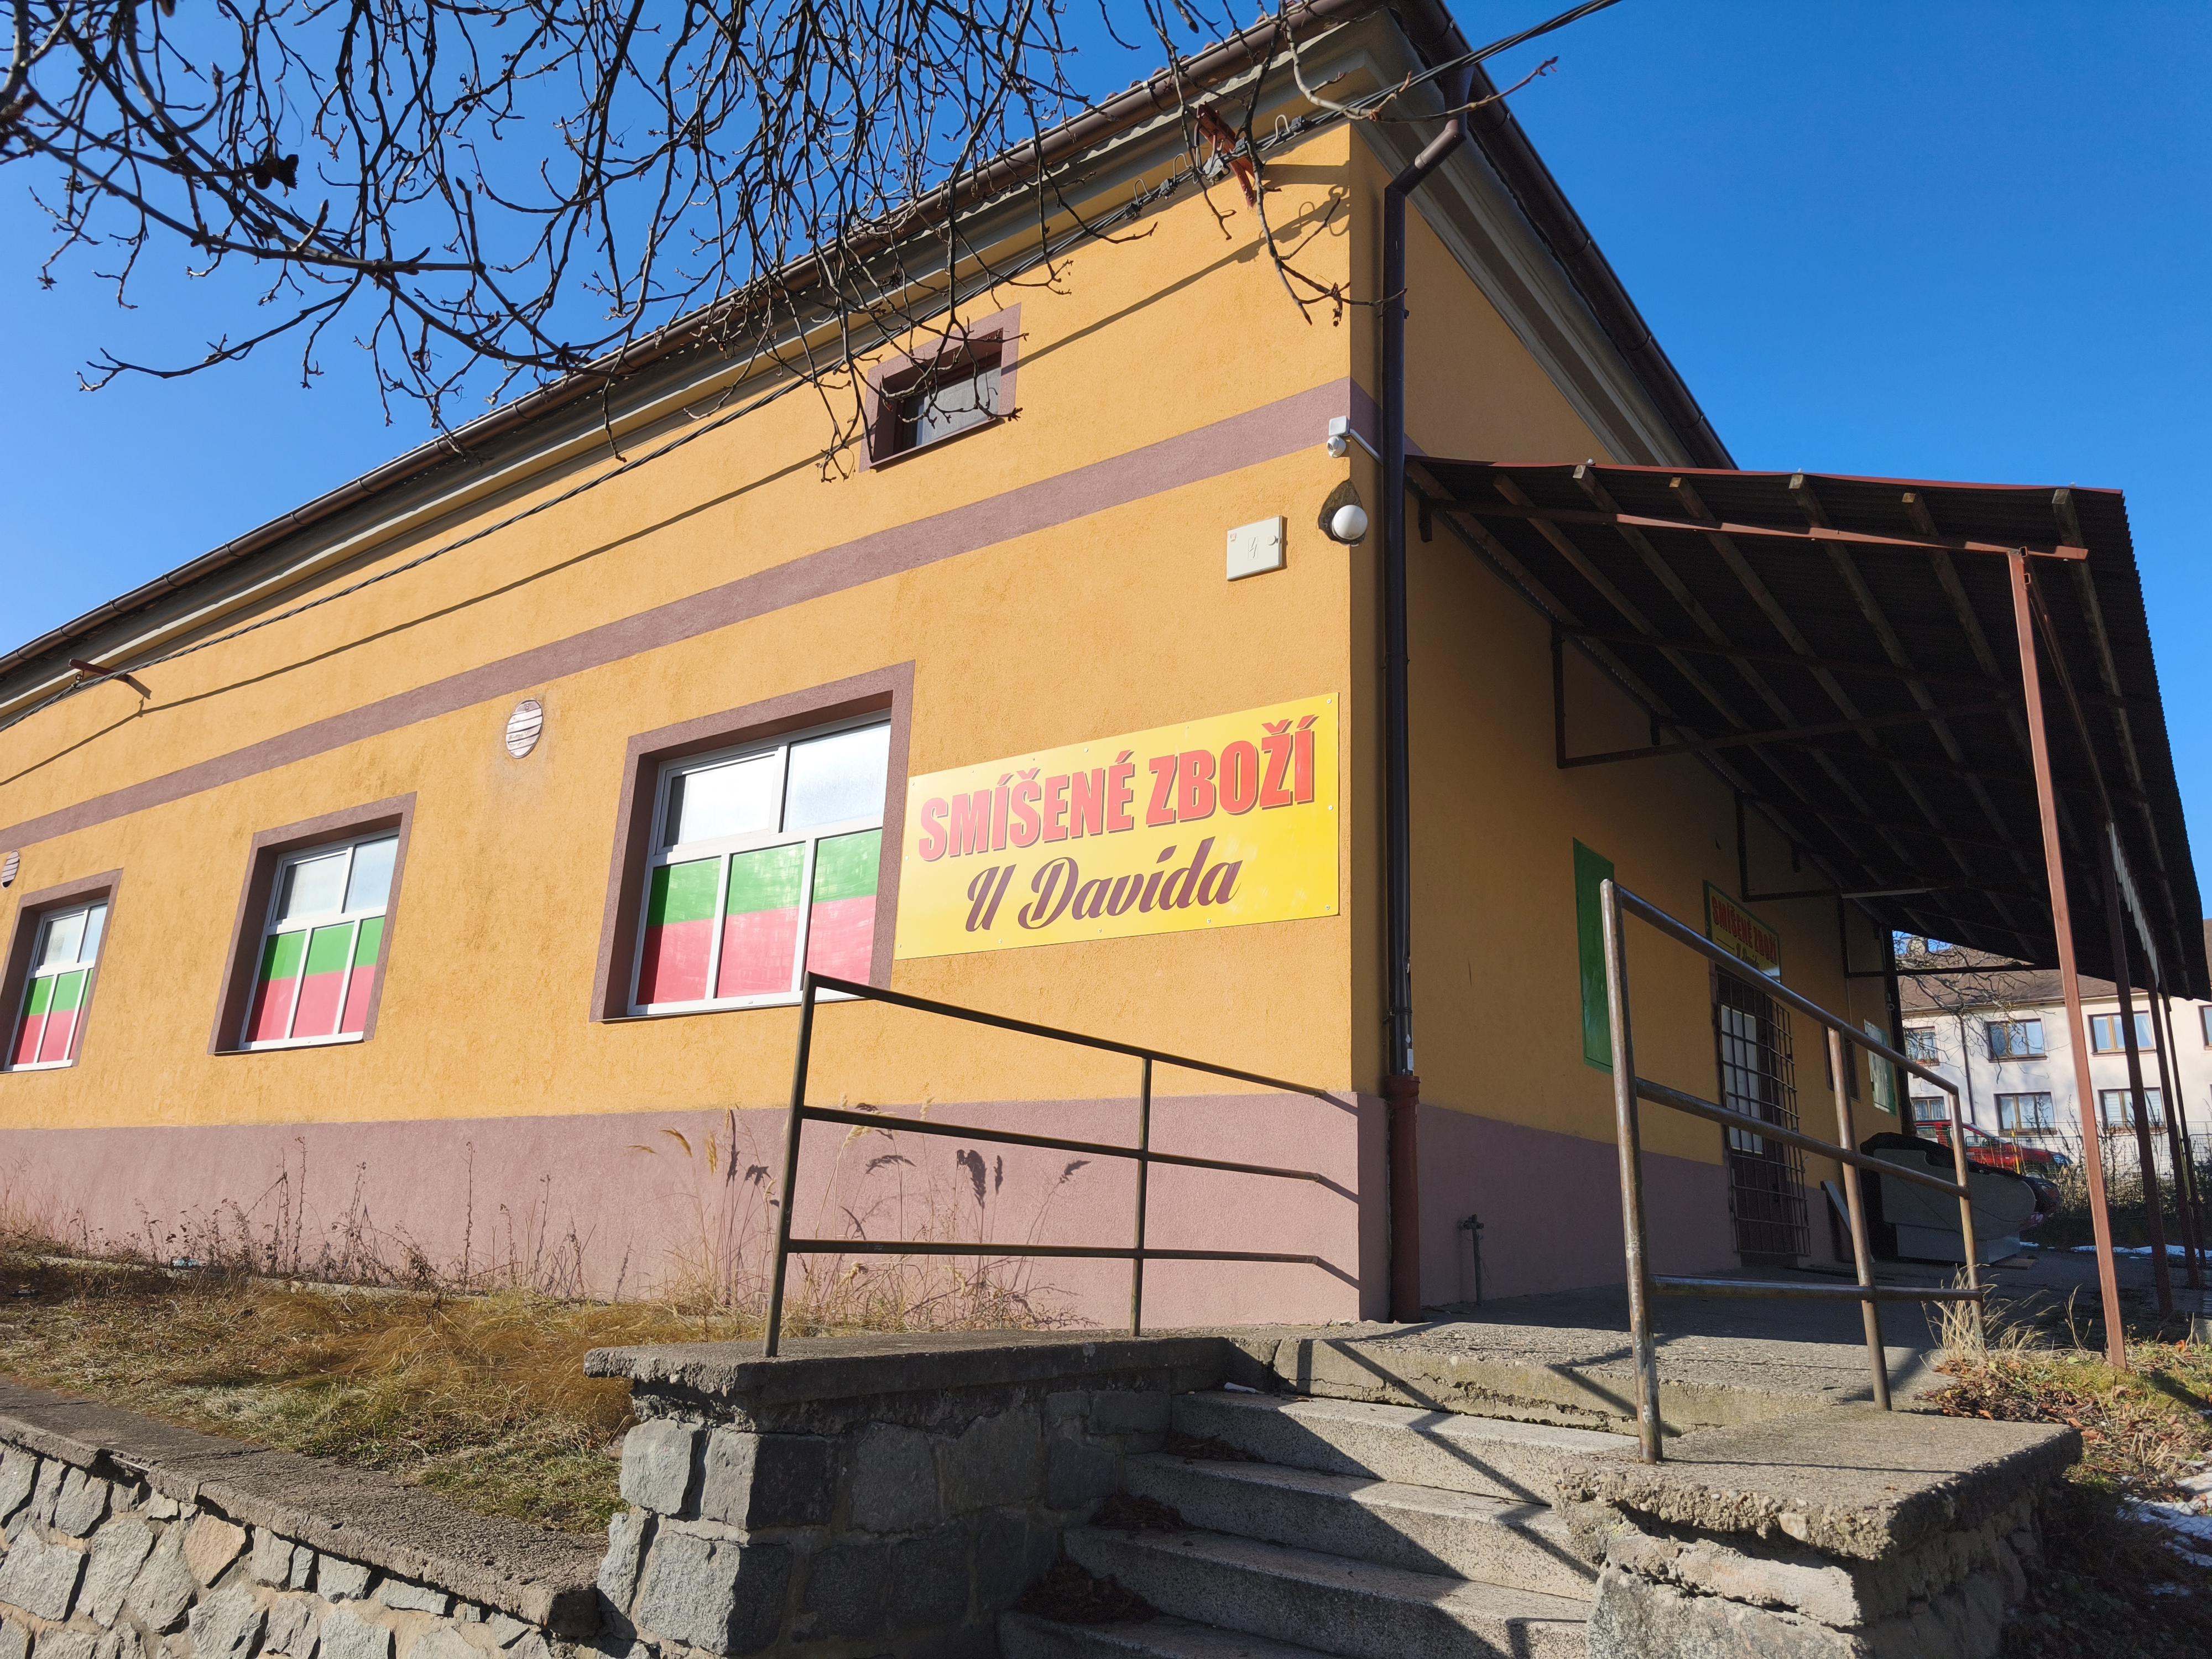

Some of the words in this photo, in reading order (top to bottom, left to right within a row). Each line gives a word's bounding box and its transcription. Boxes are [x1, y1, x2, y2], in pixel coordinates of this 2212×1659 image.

[919, 749, 1135, 862] SMÍŠENÉ
[1146, 714, 1319, 826] ZBOŽÍ
[965, 863, 1017, 932] U
[1018, 836, 1243, 930] Davida
[1712, 896, 1753, 950] SMÍŠENÉ
